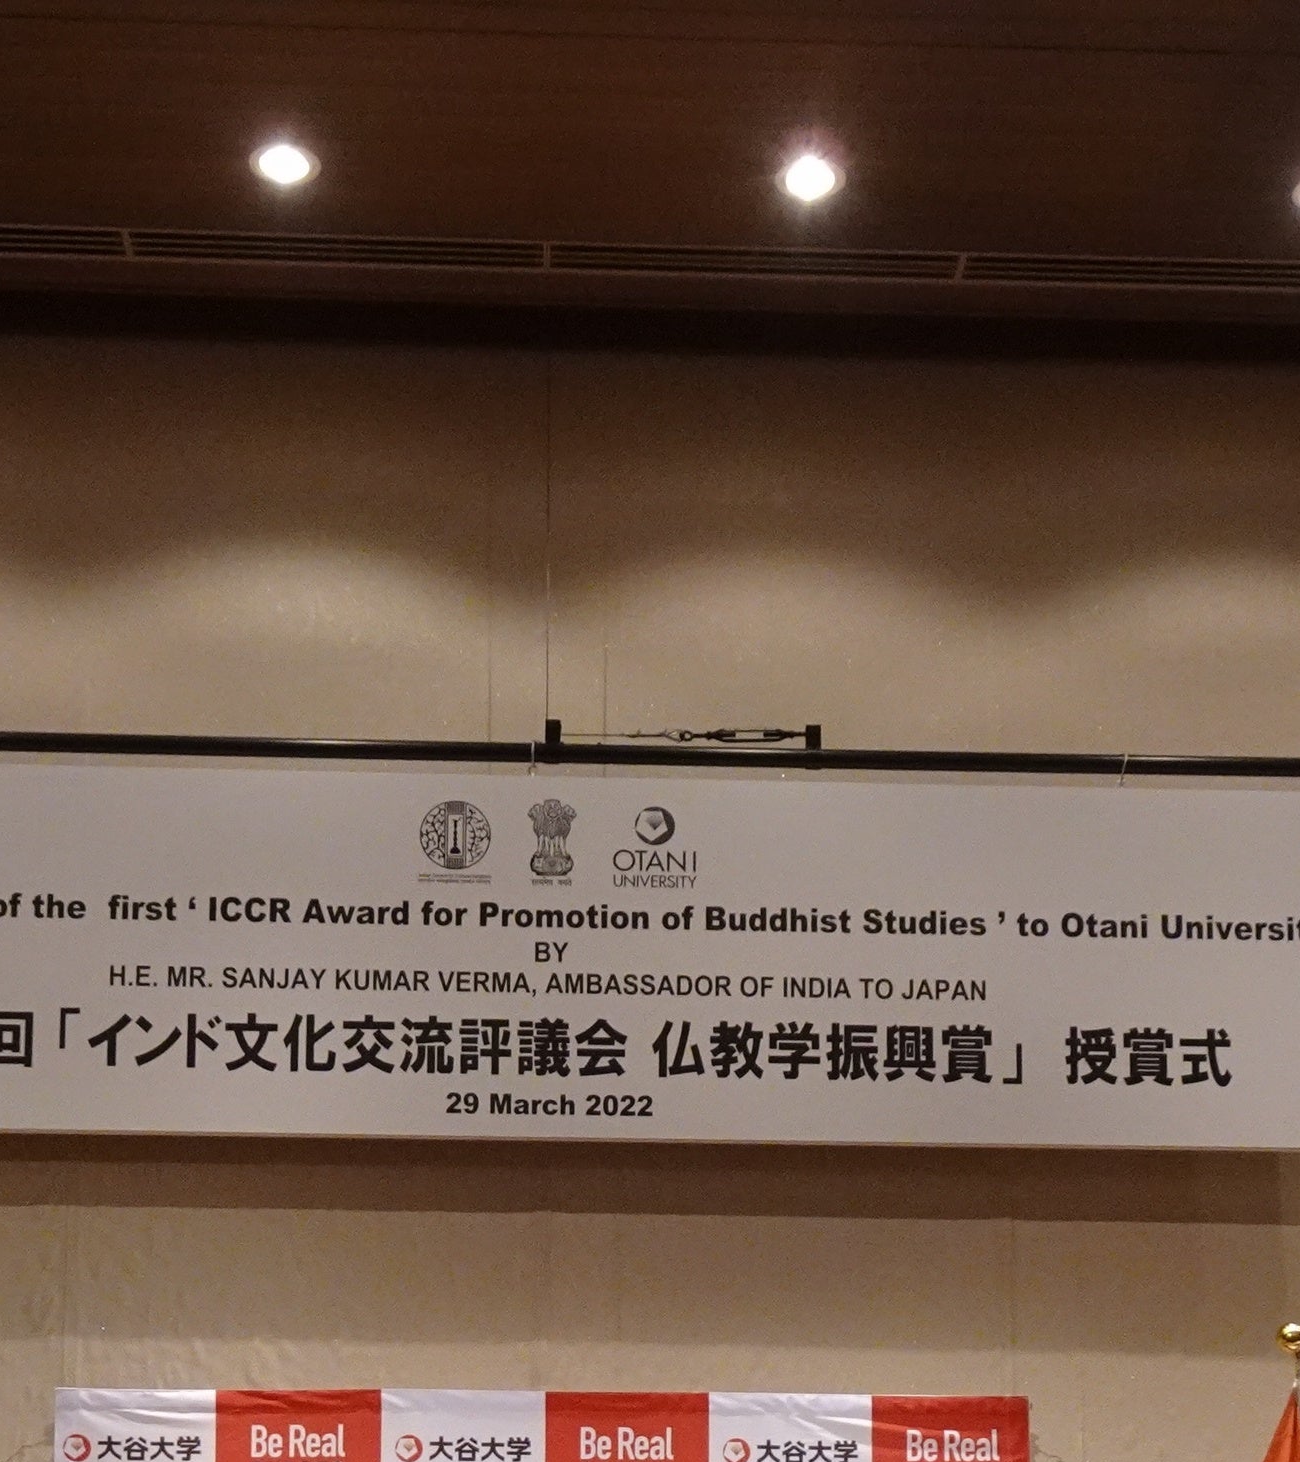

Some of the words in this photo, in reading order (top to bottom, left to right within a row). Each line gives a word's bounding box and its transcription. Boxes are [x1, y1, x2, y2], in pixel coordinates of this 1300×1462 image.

[612, 849, 697, 873] OTANI
[612, 874, 697, 889] UNIVERSITY
[31, 892, 87, 920] the
[107, 893, 178, 922] first
[301, 897, 410, 927] Award
[420, 899, 469, 927] for
[478, 901, 650, 930] Promotion
[661, 905, 695, 931] of
[704, 905, 852, 934] Buddhist
[1016, 912, 1050, 938] to
[1060, 911, 1149, 939] Otani
[534, 941, 569, 964] BY
[109, 964, 159, 988] H.E.
[167, 965, 213, 989] MR.
[221, 966, 327, 990] SANJAY
[334, 968, 430, 992] KUMAR
[437, 970, 537, 998] VERMA,
[544, 972, 732, 997] AMBASSADOR
[739, 975, 775, 998] OF
[782, 976, 852, 1000] INDIA
[858, 977, 894, 1001] TO
[900, 978, 987, 1002] JAPAN
[1064, 1025, 1233, 1088] 授賞式
[445, 1091, 480, 1115] 29
[489, 1092, 576, 1117] March
[585, 1094, 654, 1118] 2022
[97, 1435, 201, 1462] 大谷大学
[250, 1424, 284, 1458] Be
[288, 1424, 346, 1458] Real
[429, 1436, 532, 1462] 大谷大学
[579, 1426, 612, 1460] Be
[617, 1426, 674, 1460] Real
[906, 1428, 938, 1462] Be
[943, 1429, 1001, 1462] Real
